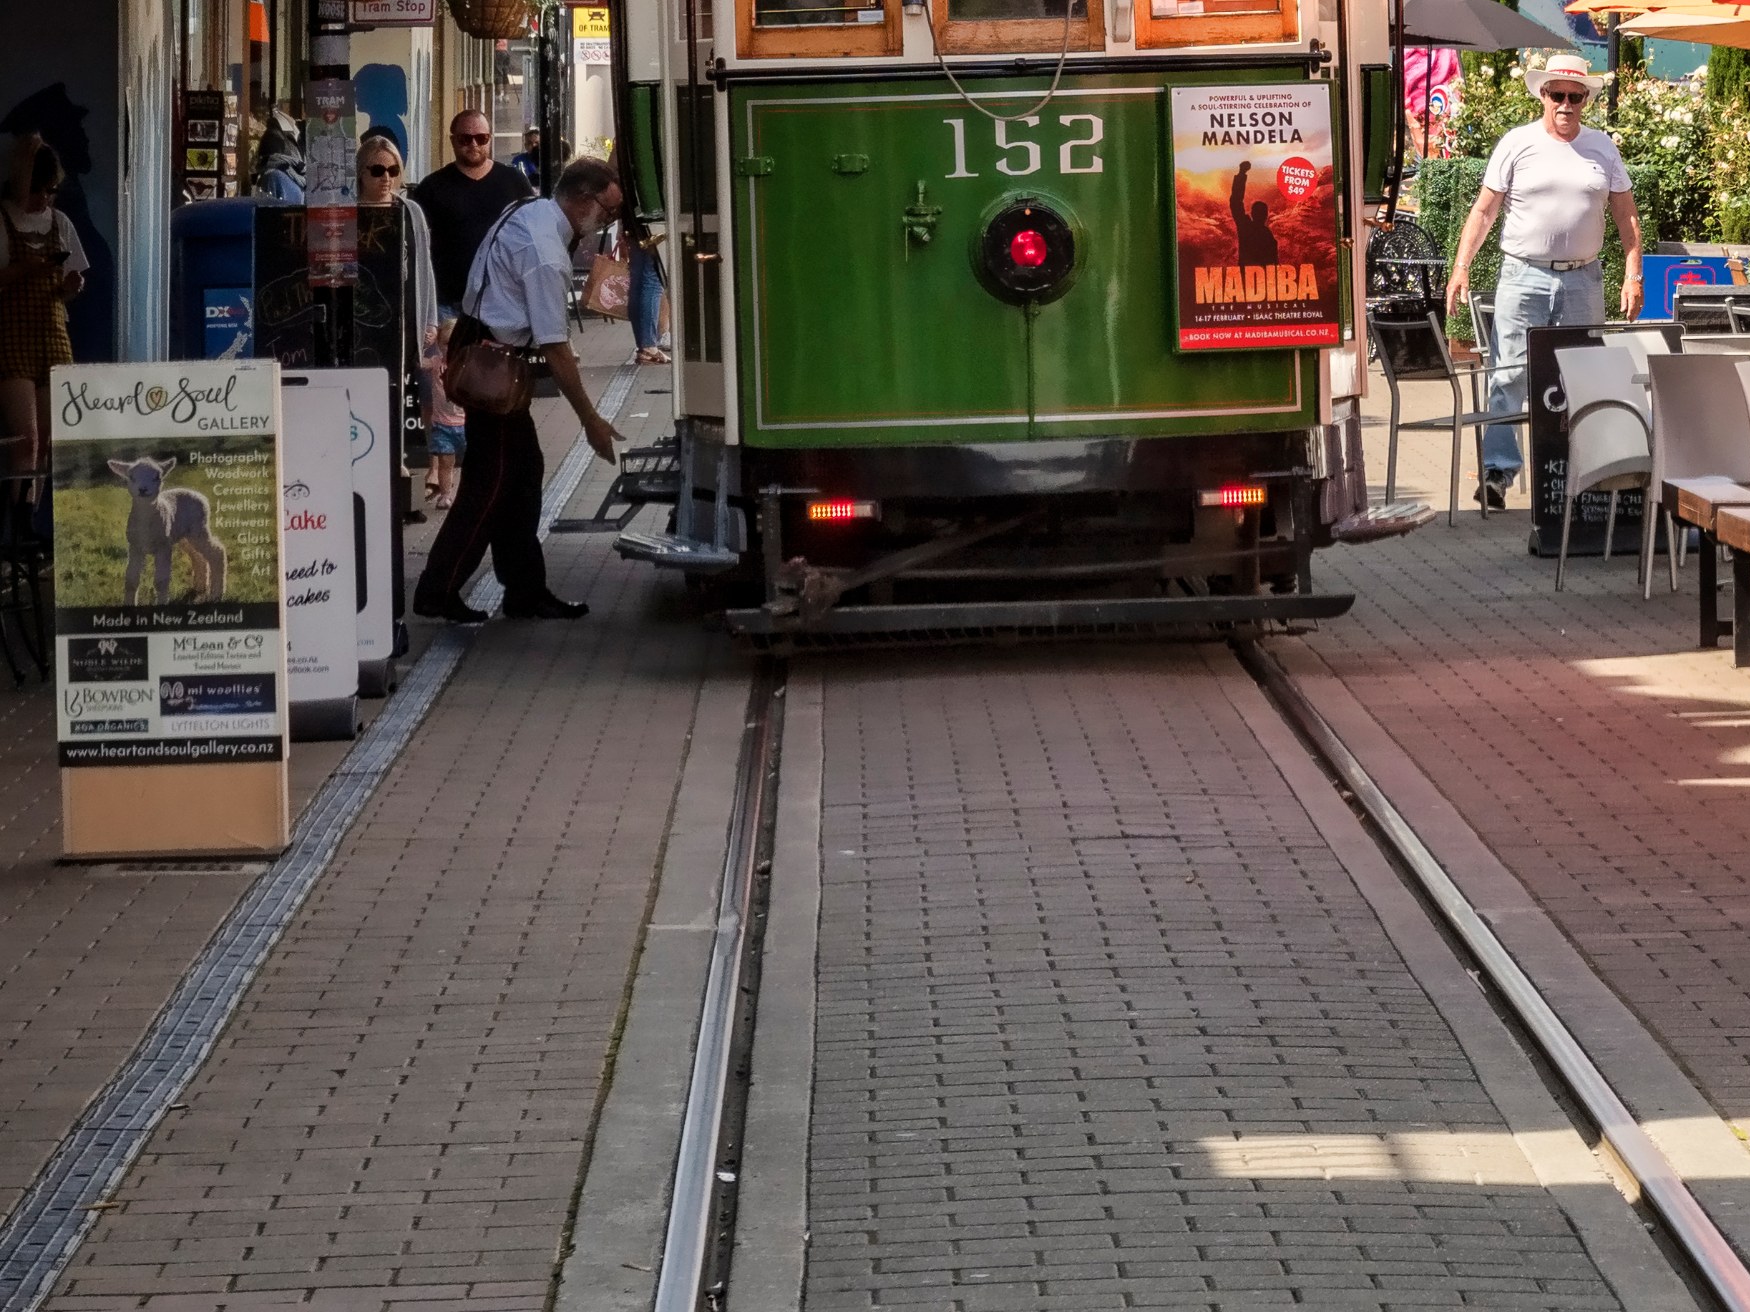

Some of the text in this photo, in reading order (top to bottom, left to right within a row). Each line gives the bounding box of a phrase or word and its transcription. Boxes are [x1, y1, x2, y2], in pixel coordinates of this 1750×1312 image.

[363, 0, 426, 14] Tram Stop
[316, 96, 345, 105] TRAM
[1256, 93, 1293, 101] UPLIFTING
[1198, 102, 1252, 110] SOUL-STIRRING
[1254, 101, 1300, 109] CELEBRATION
[1210, 111, 1293, 128] NELSON
[1202, 129, 1303, 146] MANDELA
[943, 114, 1105, 177] 152
[1281, 165, 1315, 178] TICKETS
[1284, 175, 1310, 187] FROM
[1288, 186, 1305, 195] $49
[1195, 263, 1319, 304] MADIBA
[205, 306, 231, 318] DX
[1189, 333, 1210, 341] BOOK
[1213, 332, 1231, 340] NOW
[1245, 329, 1329, 338] MADIBAMUSICAL.CO.NZ
[61, 375, 238, 427] Heart Soul
[198, 416, 269, 430] GALLERY
[190, 450, 269, 466] Photography
[205, 468, 269, 479] Woodwork
[213, 485, 269, 496] Ceramics
[216, 500, 270, 513] Jewellery
[215, 517, 269, 528] Knitwear
[237, 533, 270, 544] Glass
[241, 548, 271, 560] Gifts
[252, 565, 271, 577] Art
[321, 558, 337, 576] to
[287, 588, 330, 608] cakes
[93, 610, 243, 627] Made in New Zealand
[227, 637, 242, 650] &
[83, 687, 154, 704] BOWRON
[171, 718, 270, 732] LYTTELTON LIGHTS
[67, 741, 274, 759] www.heartandsoulgallery.co.nz
